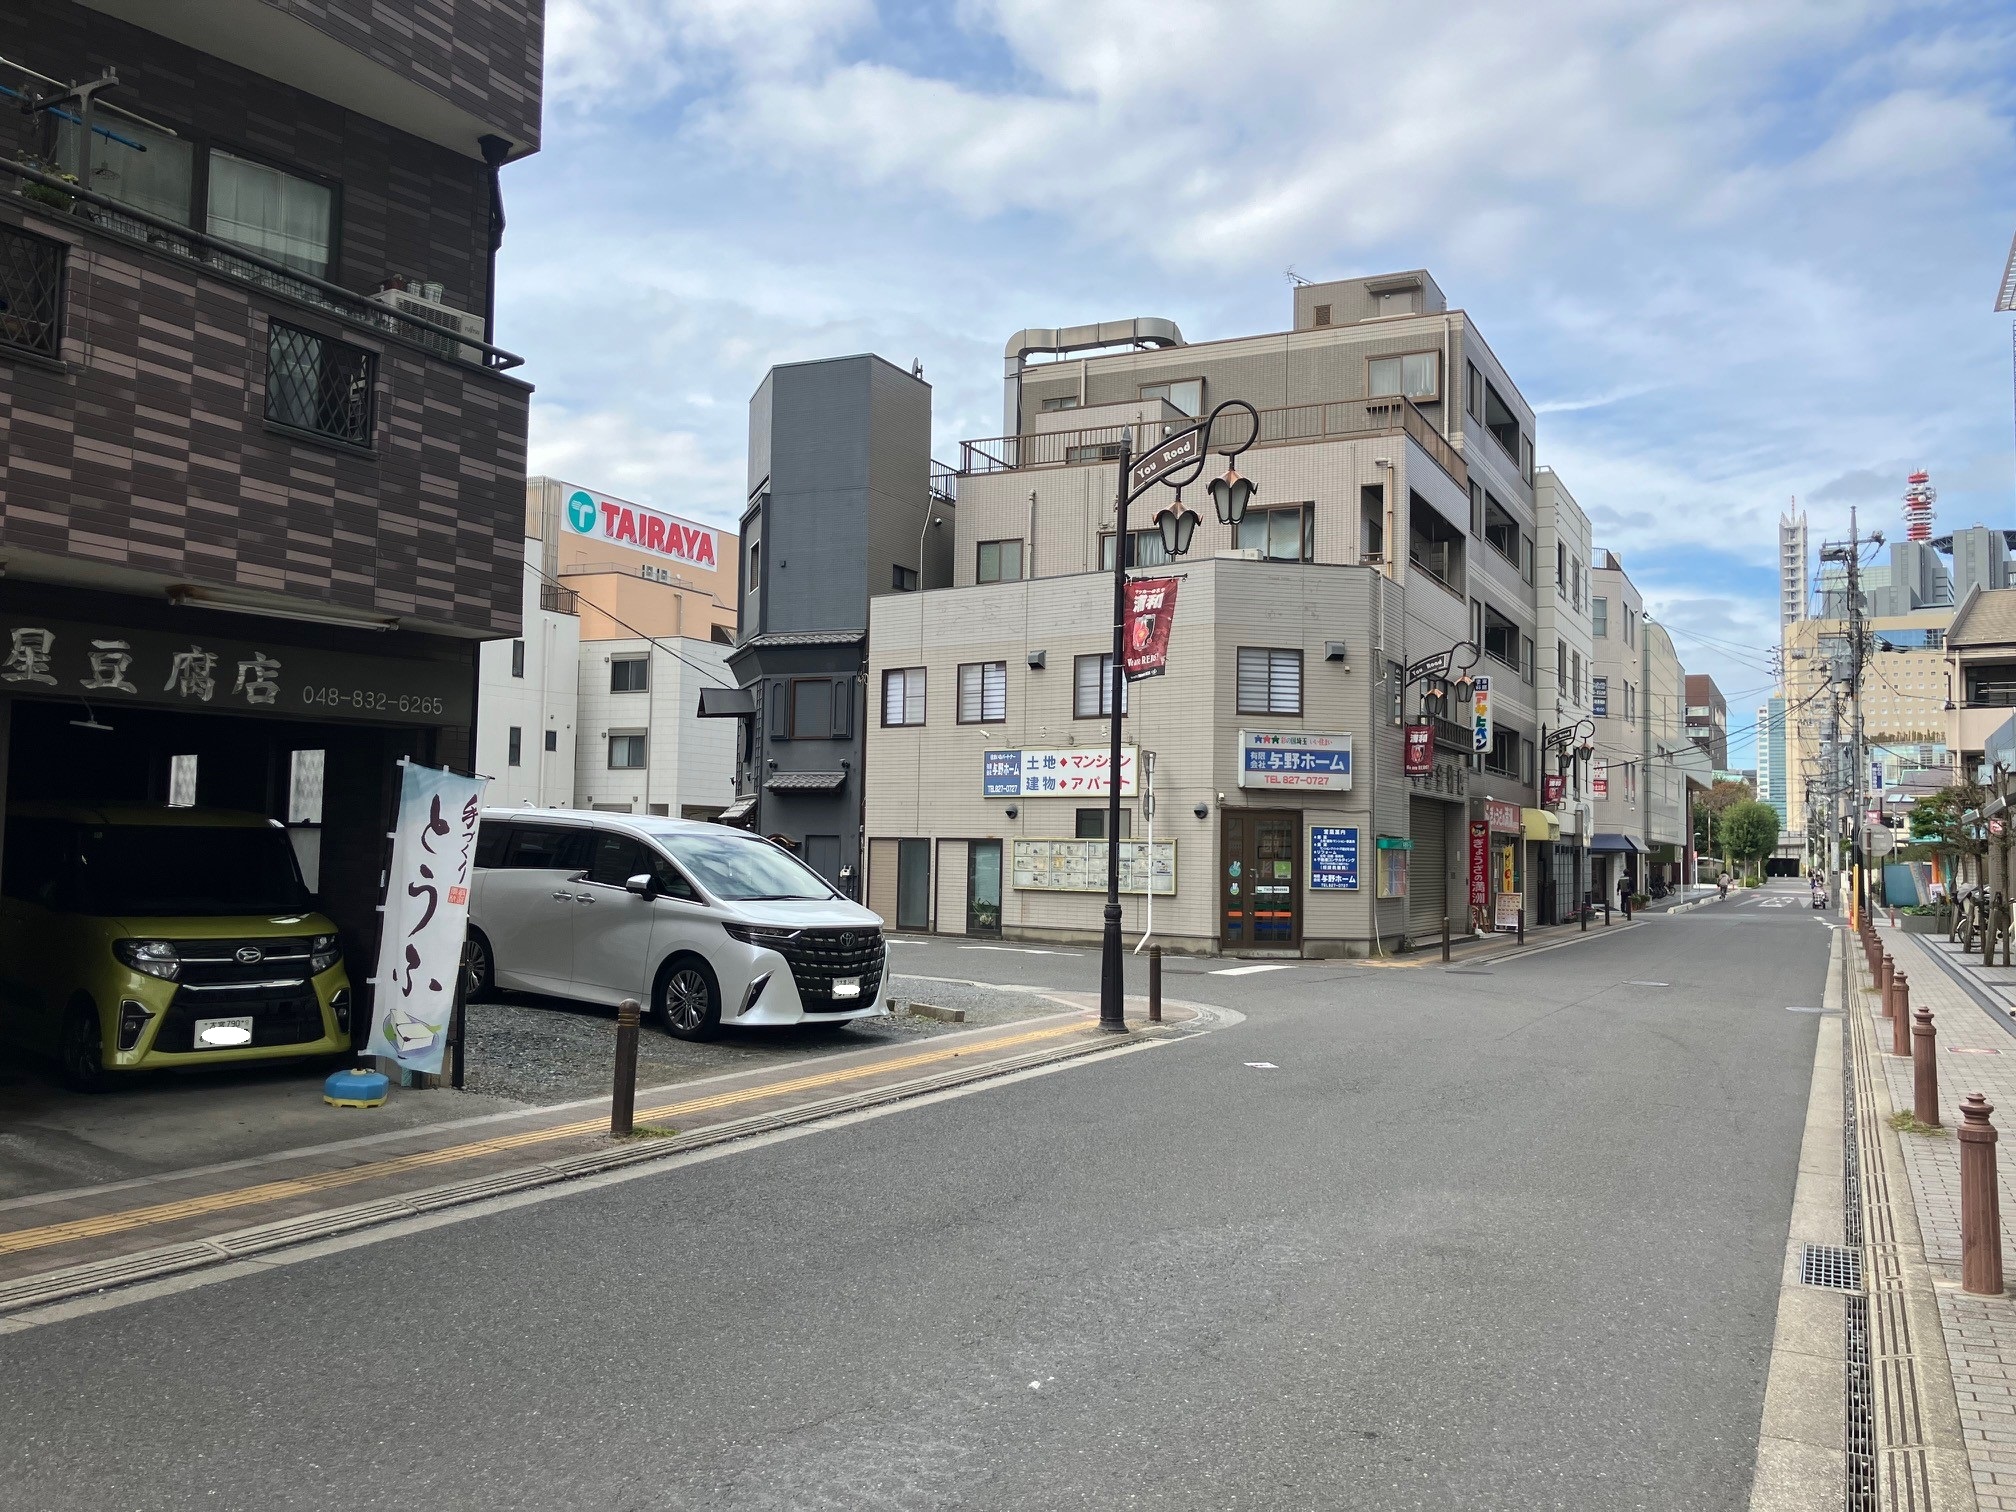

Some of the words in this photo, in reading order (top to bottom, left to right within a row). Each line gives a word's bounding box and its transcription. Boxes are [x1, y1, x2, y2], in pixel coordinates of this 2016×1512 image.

[1137, 462, 1157, 479] You
[1163, 441, 1191, 462] Road
[601, 501, 716, 566] TAIRAYA
[1133, 593, 1165, 612] 浦和
[1, 627, 282, 705] 星豆腐店
[303, 685, 443, 715] 048-832-6265
[1474, 692, 1488, 751] アサヒペン
[1026, 755, 1056, 770] 土地
[1071, 754, 1131, 769] マンシン
[1267, 752, 1345, 771] 与野ホーム
[1026, 776, 1056, 791] 建物
[1264, 775, 1281, 784] TEL
[1282, 776, 1330, 785] 827-0727
[457, 793, 478, 885] 手づくり
[1320, 874, 1356, 883] 与野ホーム
[392, 793, 450, 998] とうふ
